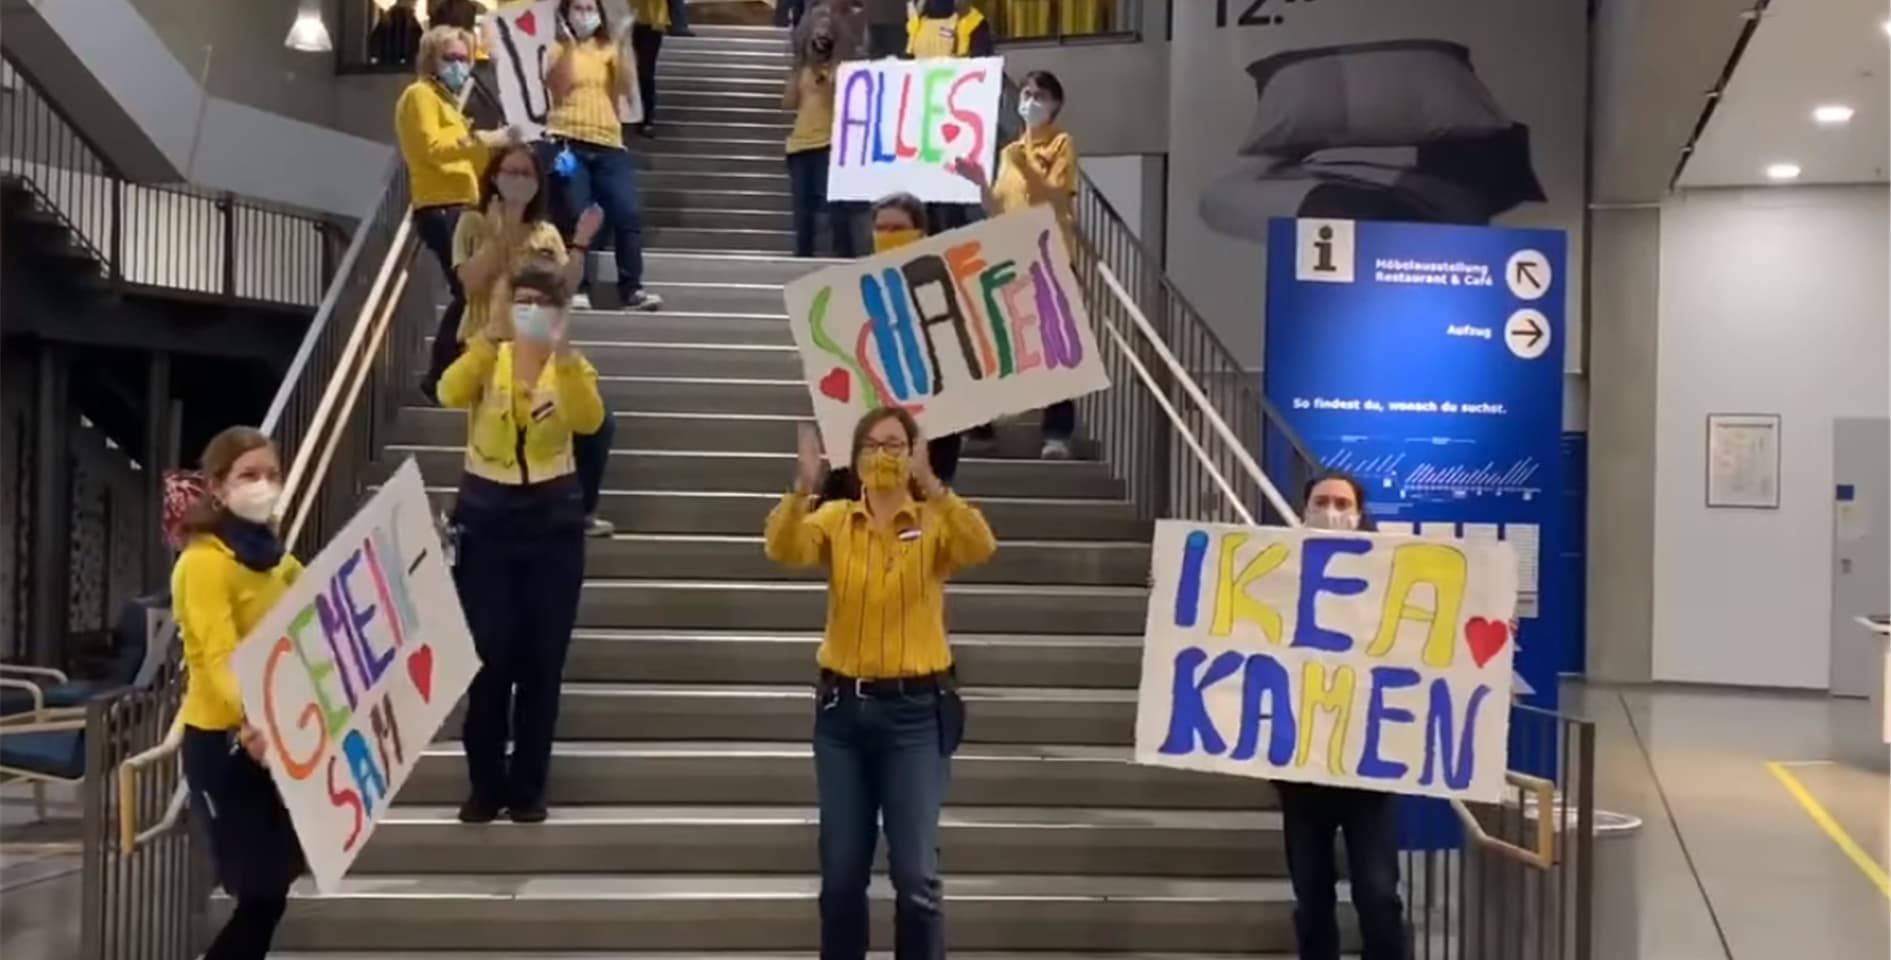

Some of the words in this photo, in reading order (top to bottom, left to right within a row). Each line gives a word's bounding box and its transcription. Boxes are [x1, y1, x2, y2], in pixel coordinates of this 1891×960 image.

[838, 69, 987, 175] ALLES
[808, 229, 1083, 415] SCHAFFEN
[1375, 271, 1448, 285] Restaurant
[1451, 274, 1461, 285] &
[1446, 323, 1492, 339] Aufzug
[1293, 397, 1310, 409] So
[1313, 397, 1360, 411] findest
[1363, 399, 1384, 413] du,
[1441, 401, 1457, 413] du
[1461, 402, 1507, 414] suchst.
[1174, 529, 1468, 668] IKEA
[327, 693, 404, 852] SAM
[1157, 646, 1491, 790] KAMEN
